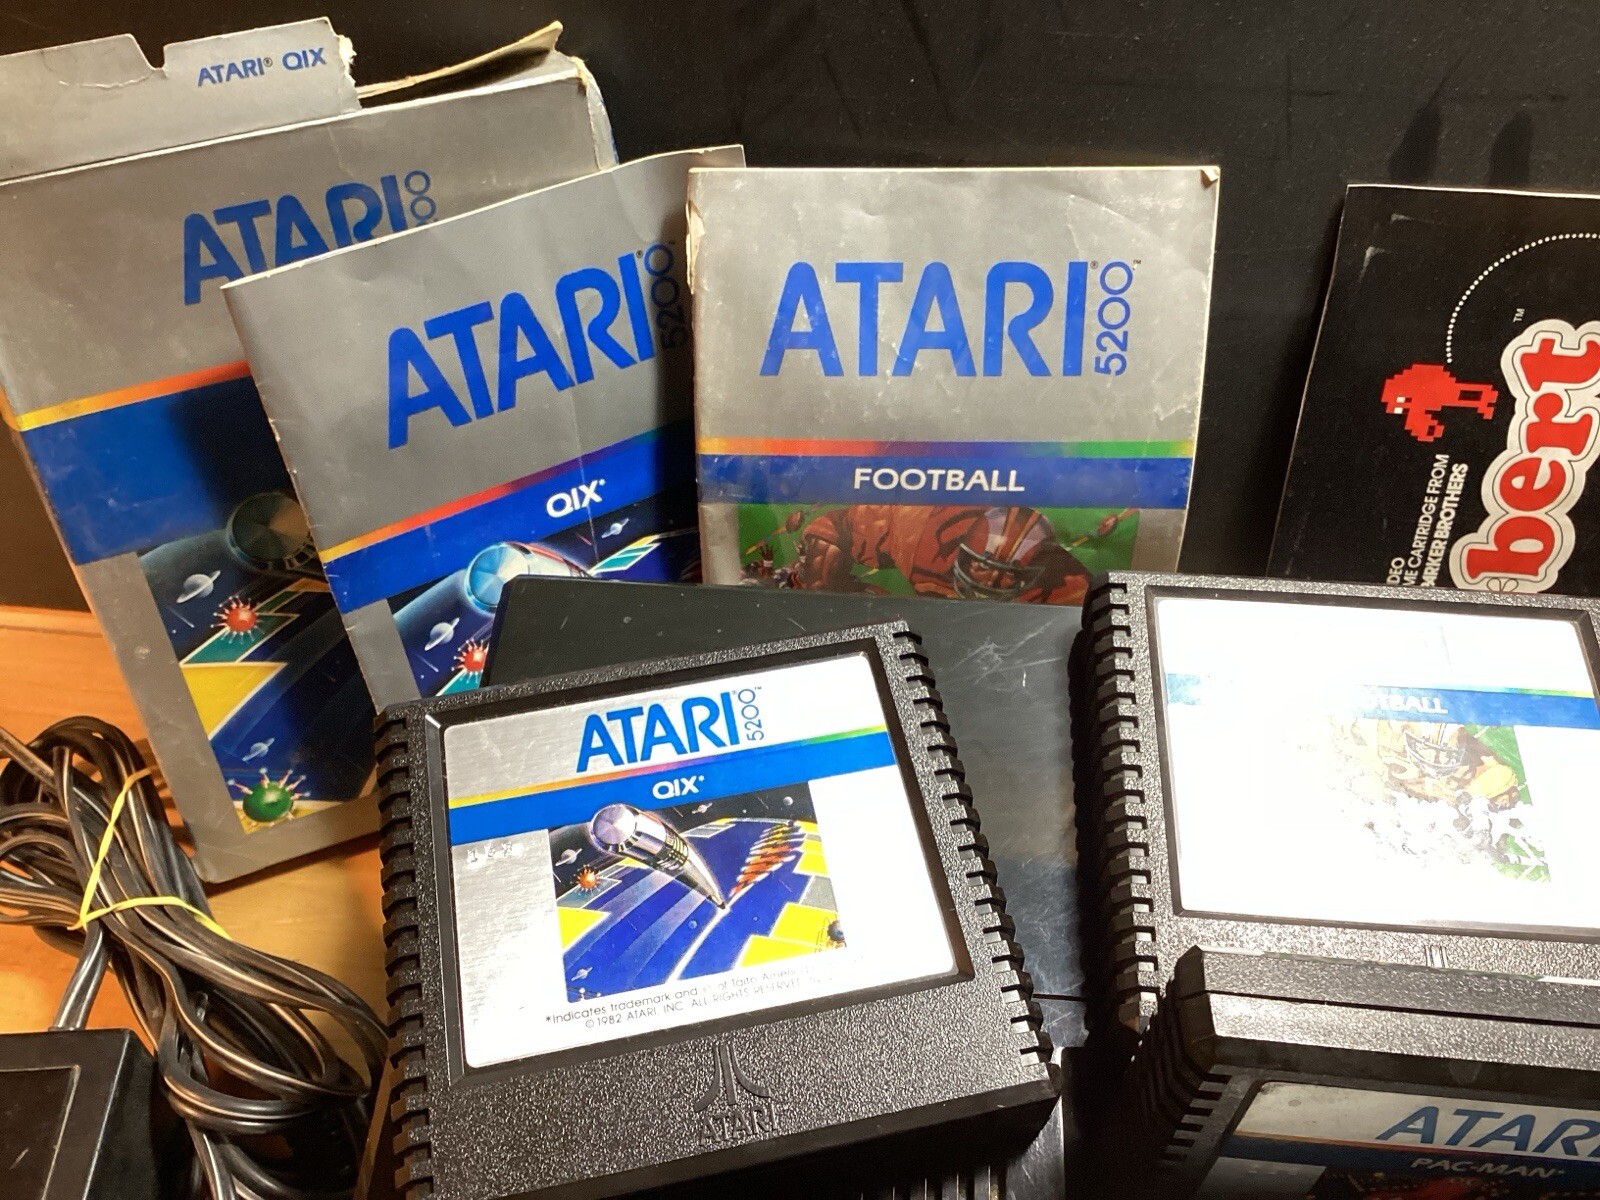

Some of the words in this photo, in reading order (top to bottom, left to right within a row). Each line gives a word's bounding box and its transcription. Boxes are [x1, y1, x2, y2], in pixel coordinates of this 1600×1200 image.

[282, 47, 327, 70] QIX
[1094, 261, 1133, 376] 5200
[854, 467, 1025, 492] FOOTBALL
[1433, 463, 1469, 540] BROTHERS
[1407, 496, 1439, 568] CARTRIDGE
[1426, 454, 1449, 494] FROM
[1420, 540, 1448, 587] ARKER
[738, 689, 765, 741] 5200
[611, 992, 671, 1011] trademark
[675, 987, 698, 1000] and
[691, 997, 708, 1008] ALL
[698, 1100, 779, 1146] ATARI
[1375, 1105, 1600, 1158] ATAR
